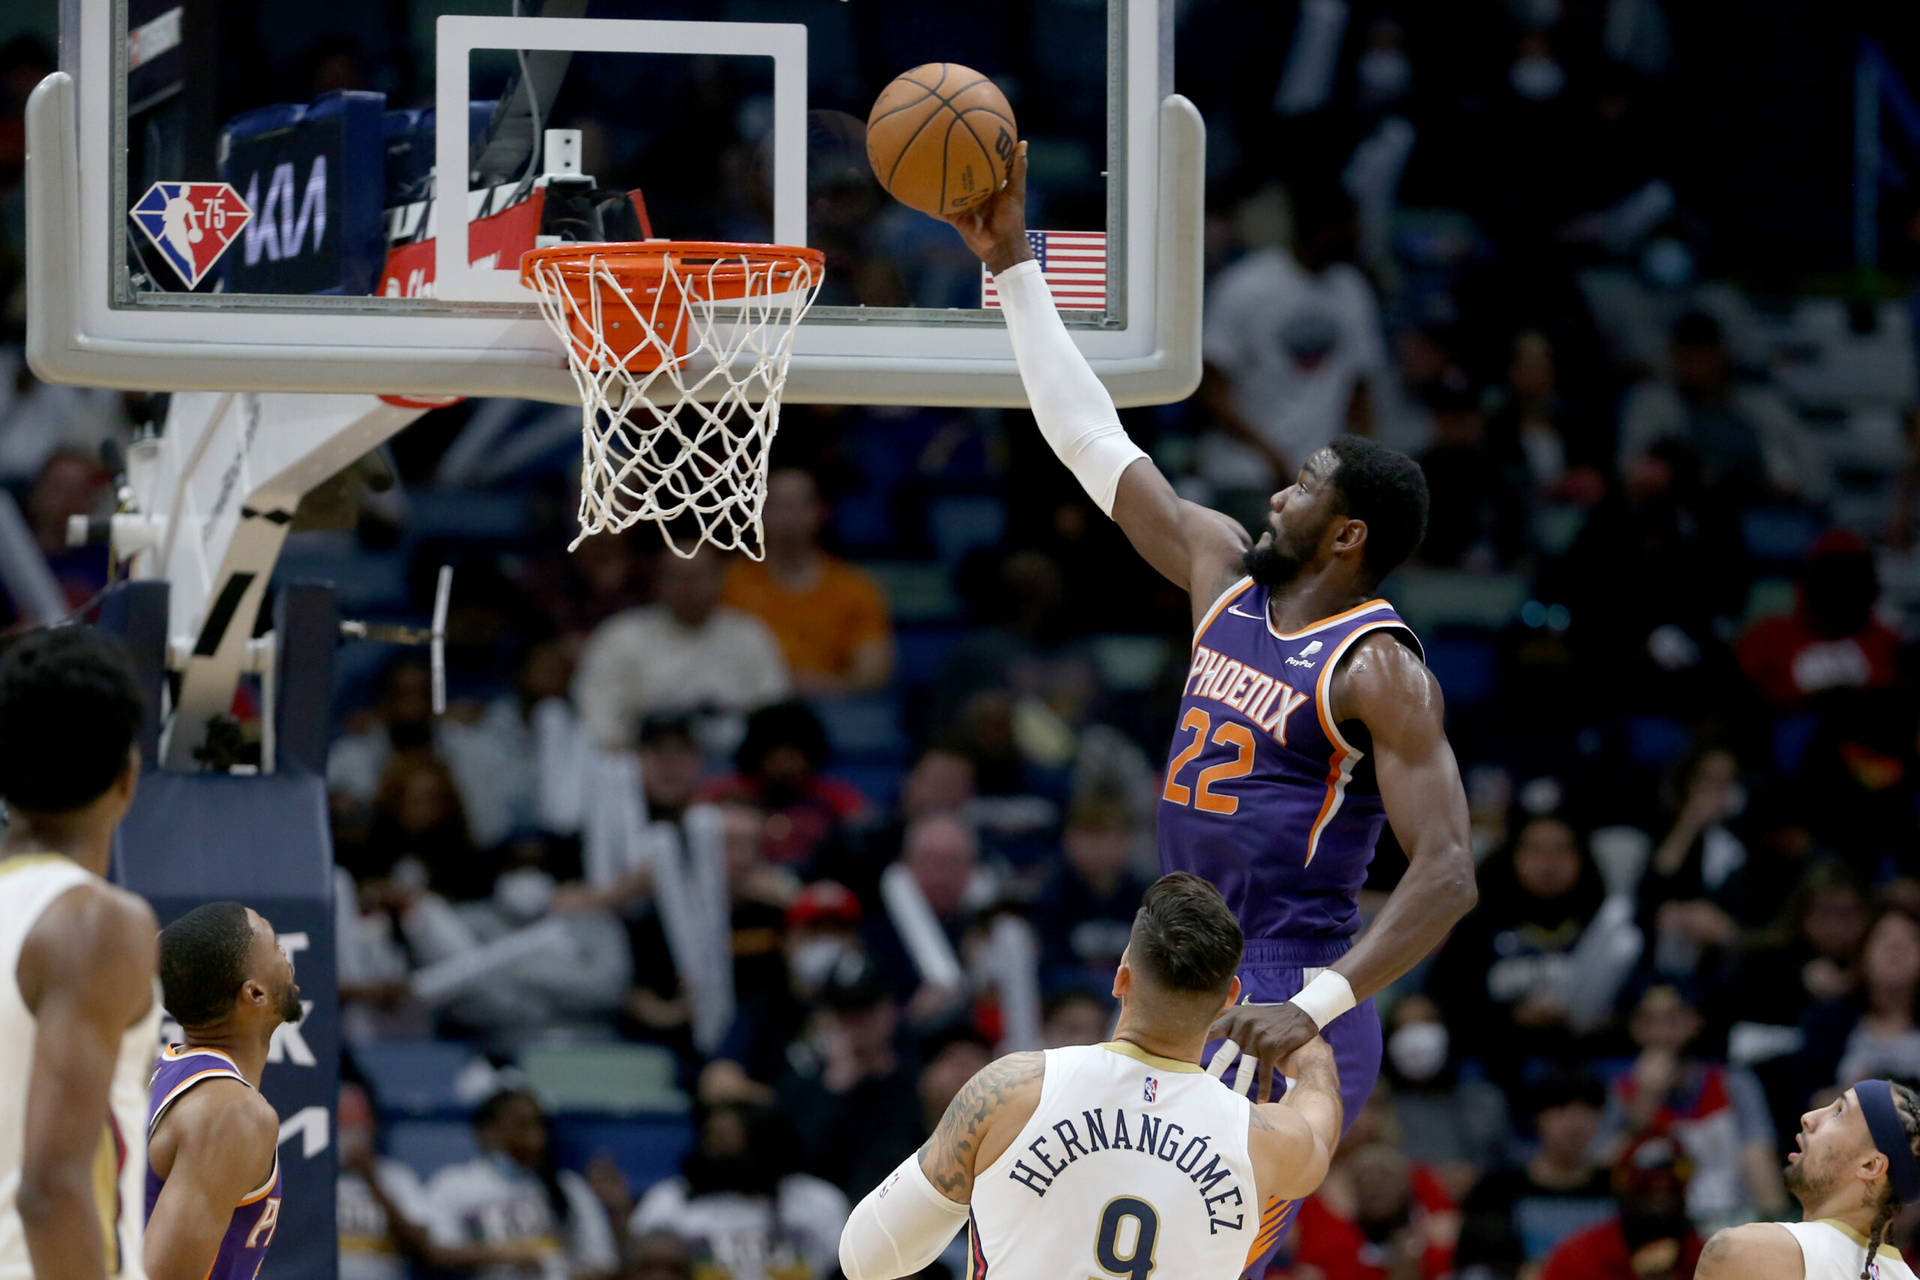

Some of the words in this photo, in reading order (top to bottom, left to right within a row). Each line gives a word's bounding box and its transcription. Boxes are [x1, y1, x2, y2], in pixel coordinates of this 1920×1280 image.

[203, 198, 226, 229] 75
[1182, 645, 1310, 746] PHOENIX
[1285, 656, 1316, 669] PayPal
[1162, 706, 1256, 815] 22
[1009, 1107, 1243, 1235] HERNANGÓMEZ
[1094, 1194, 1160, 1280] 9
